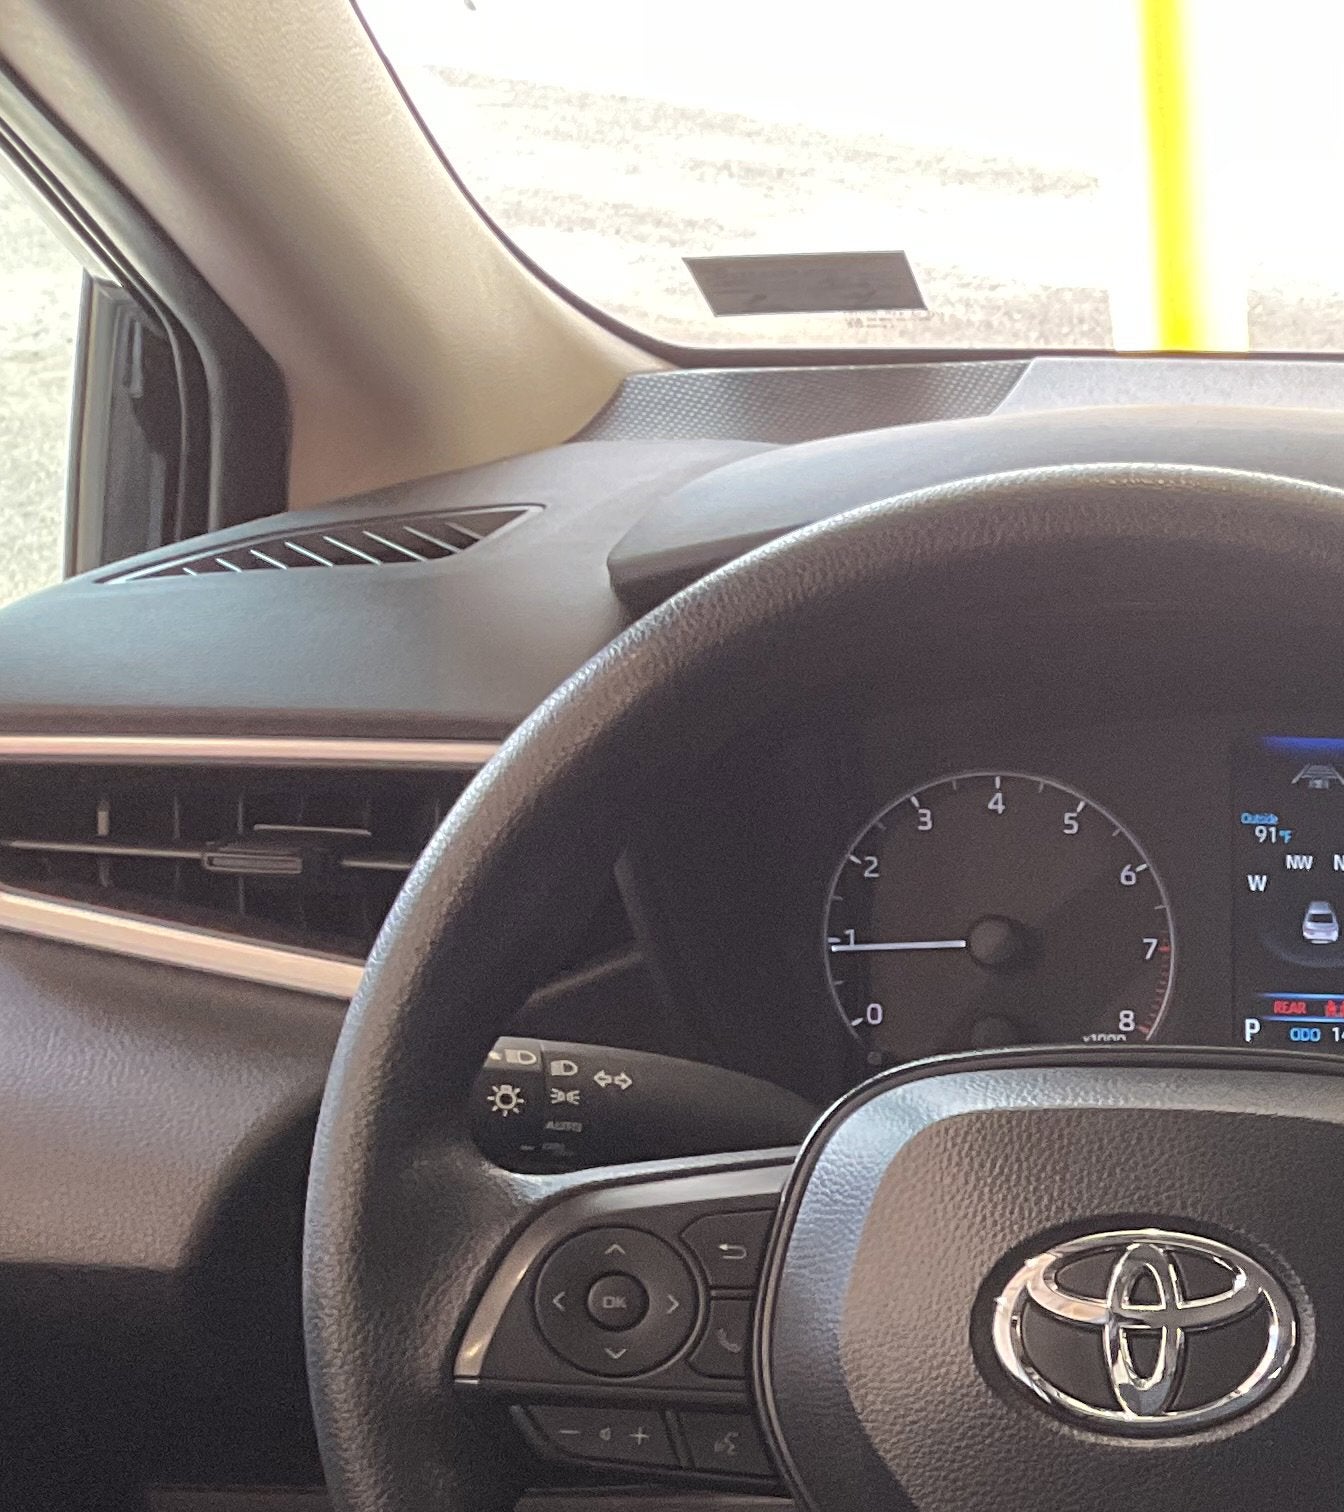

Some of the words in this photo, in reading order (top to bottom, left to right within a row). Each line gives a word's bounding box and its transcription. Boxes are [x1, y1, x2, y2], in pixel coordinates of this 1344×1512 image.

[987, 792, 1006, 815] 4
[917, 808, 933, 831] 3
[1063, 812, 1079, 834] 5
[863, 856, 880, 878] 2
[1286, 854, 1314, 871] NW
[1120, 864, 1137, 886] 6
[1248, 875, 1268, 892] W
[1142, 938, 1158, 960] 7
[867, 1003, 883, 1025] 0
[1273, 1000, 1307, 1014] REAR
[1118, 1010, 1135, 1032] 8
[1245, 1018, 1261, 1043] P
[603, 1296, 627, 1308] OK
